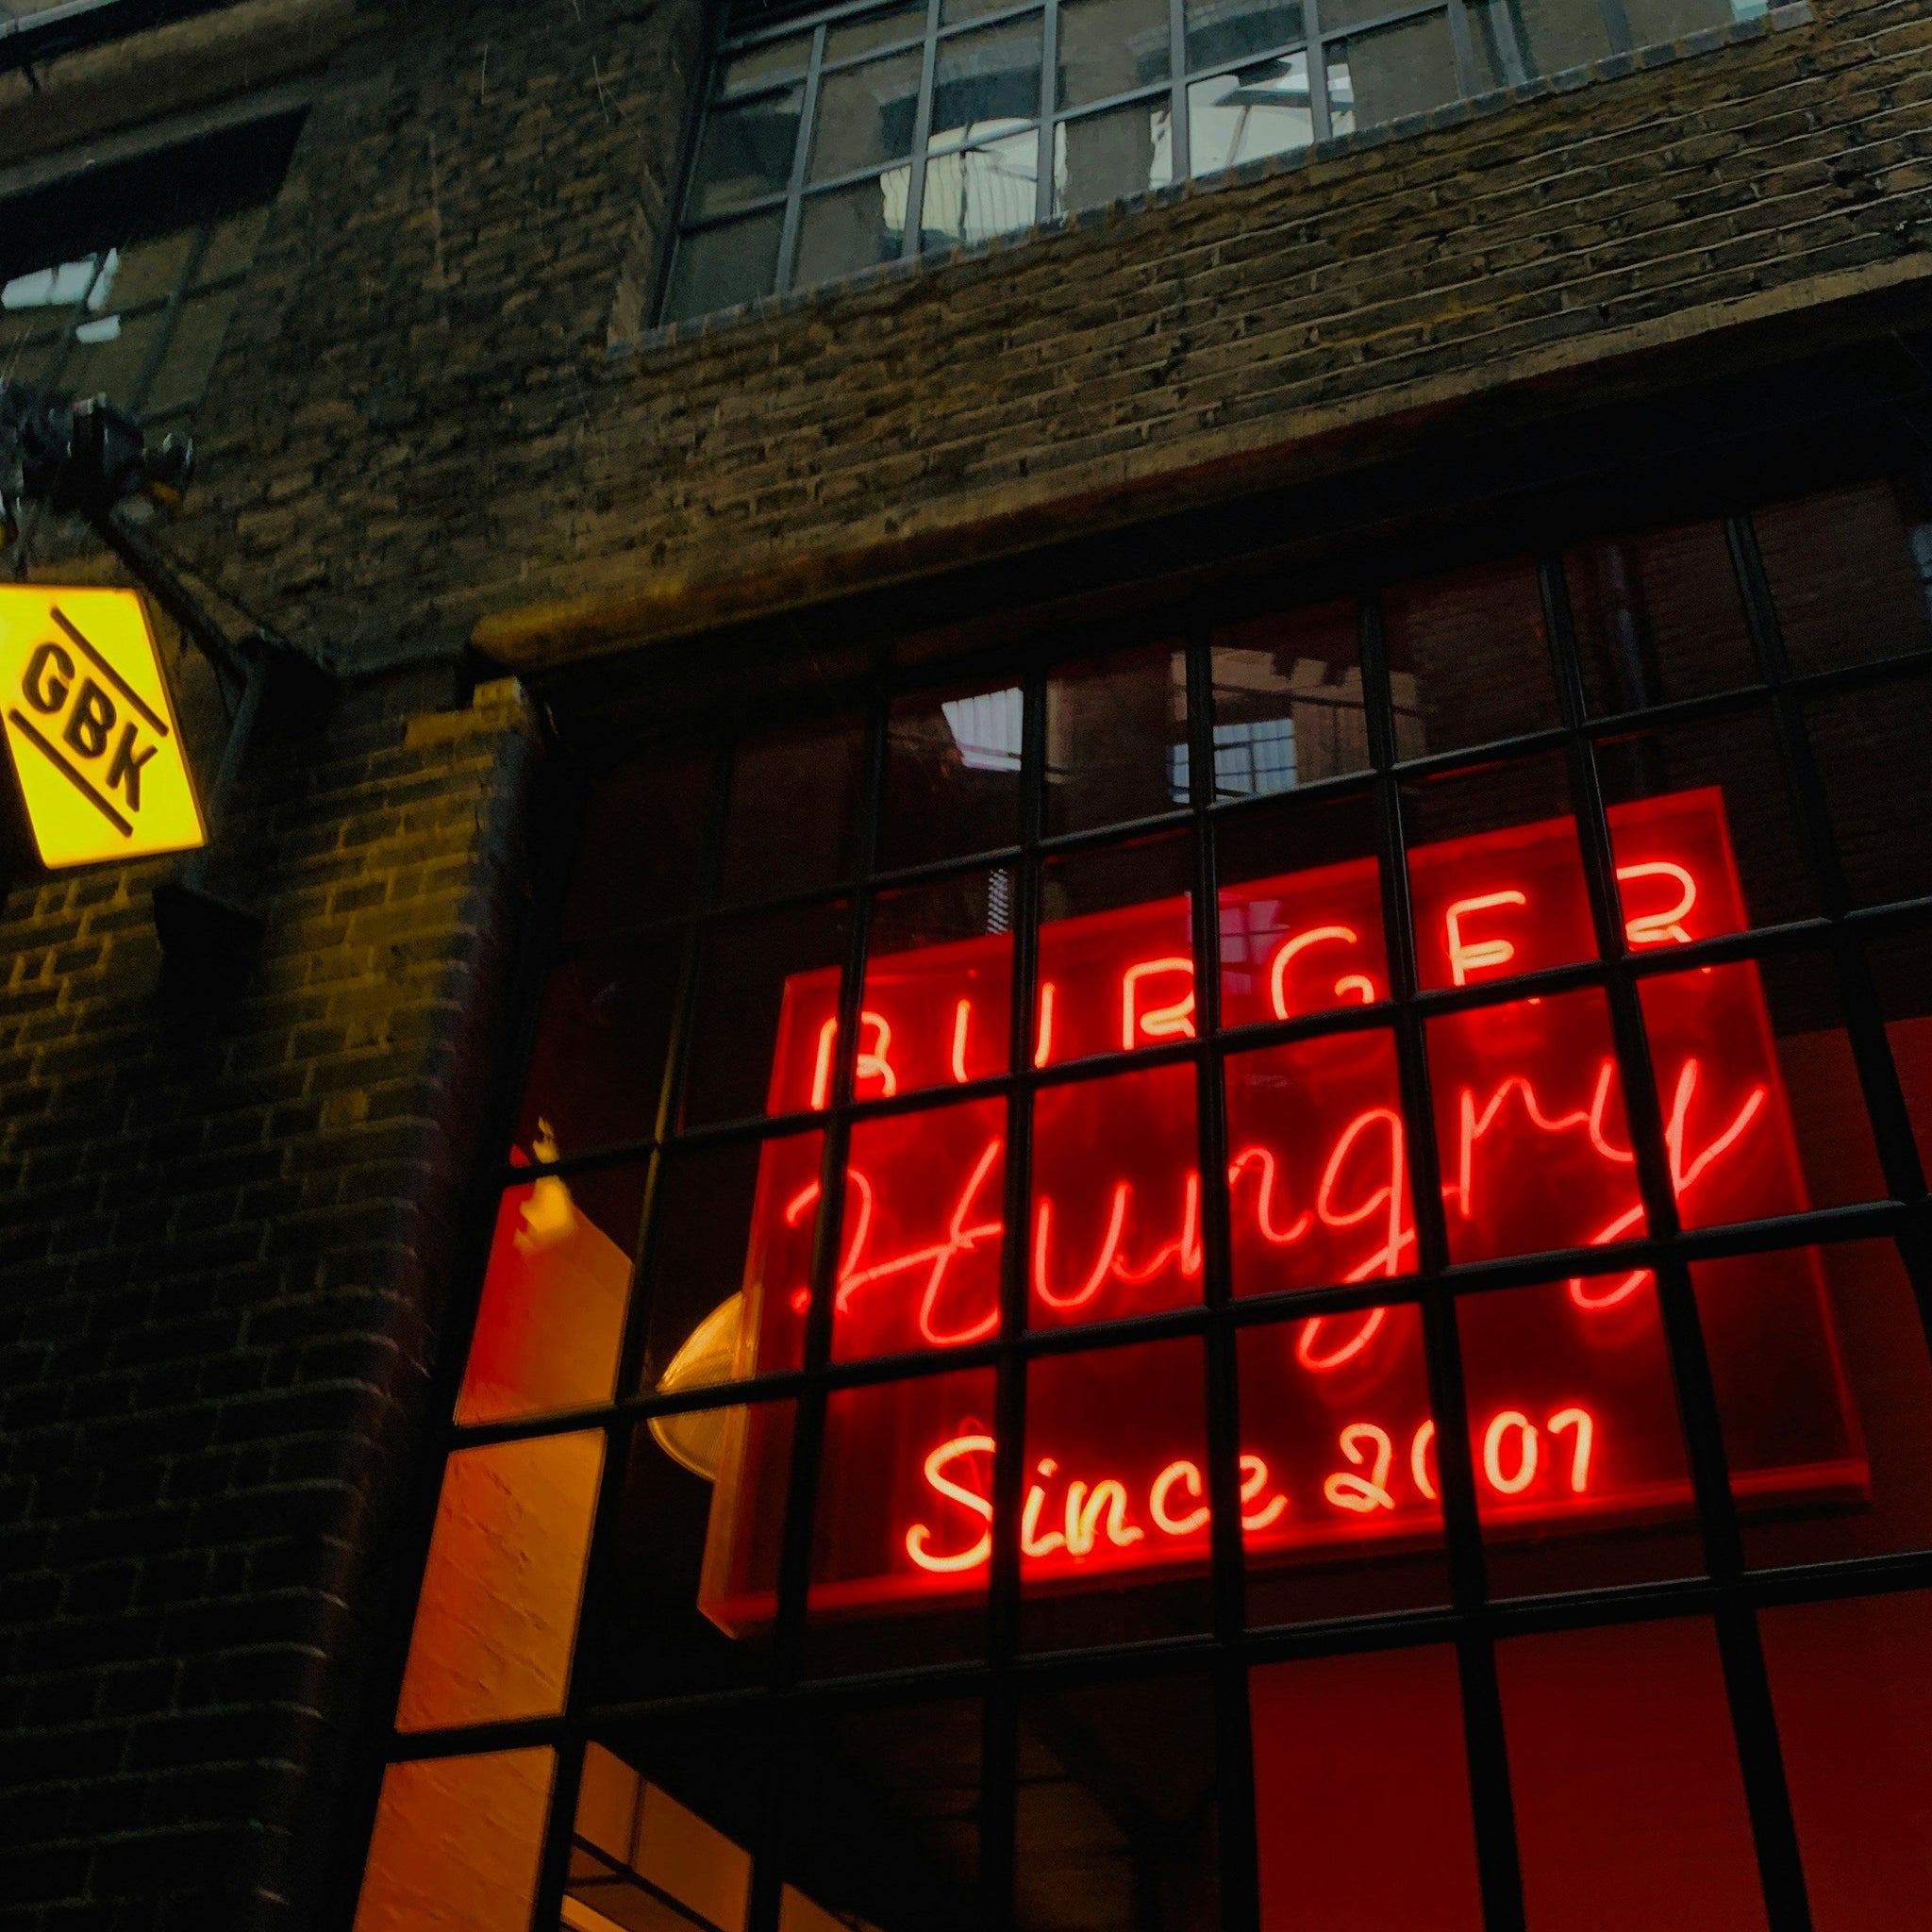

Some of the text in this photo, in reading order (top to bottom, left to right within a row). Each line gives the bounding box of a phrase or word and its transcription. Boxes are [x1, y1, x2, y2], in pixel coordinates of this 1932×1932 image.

[23, 641, 158, 812] GBK
[783, 1058, 1770, 1370] Hungry
[906, 1435, 1287, 1574] Since
